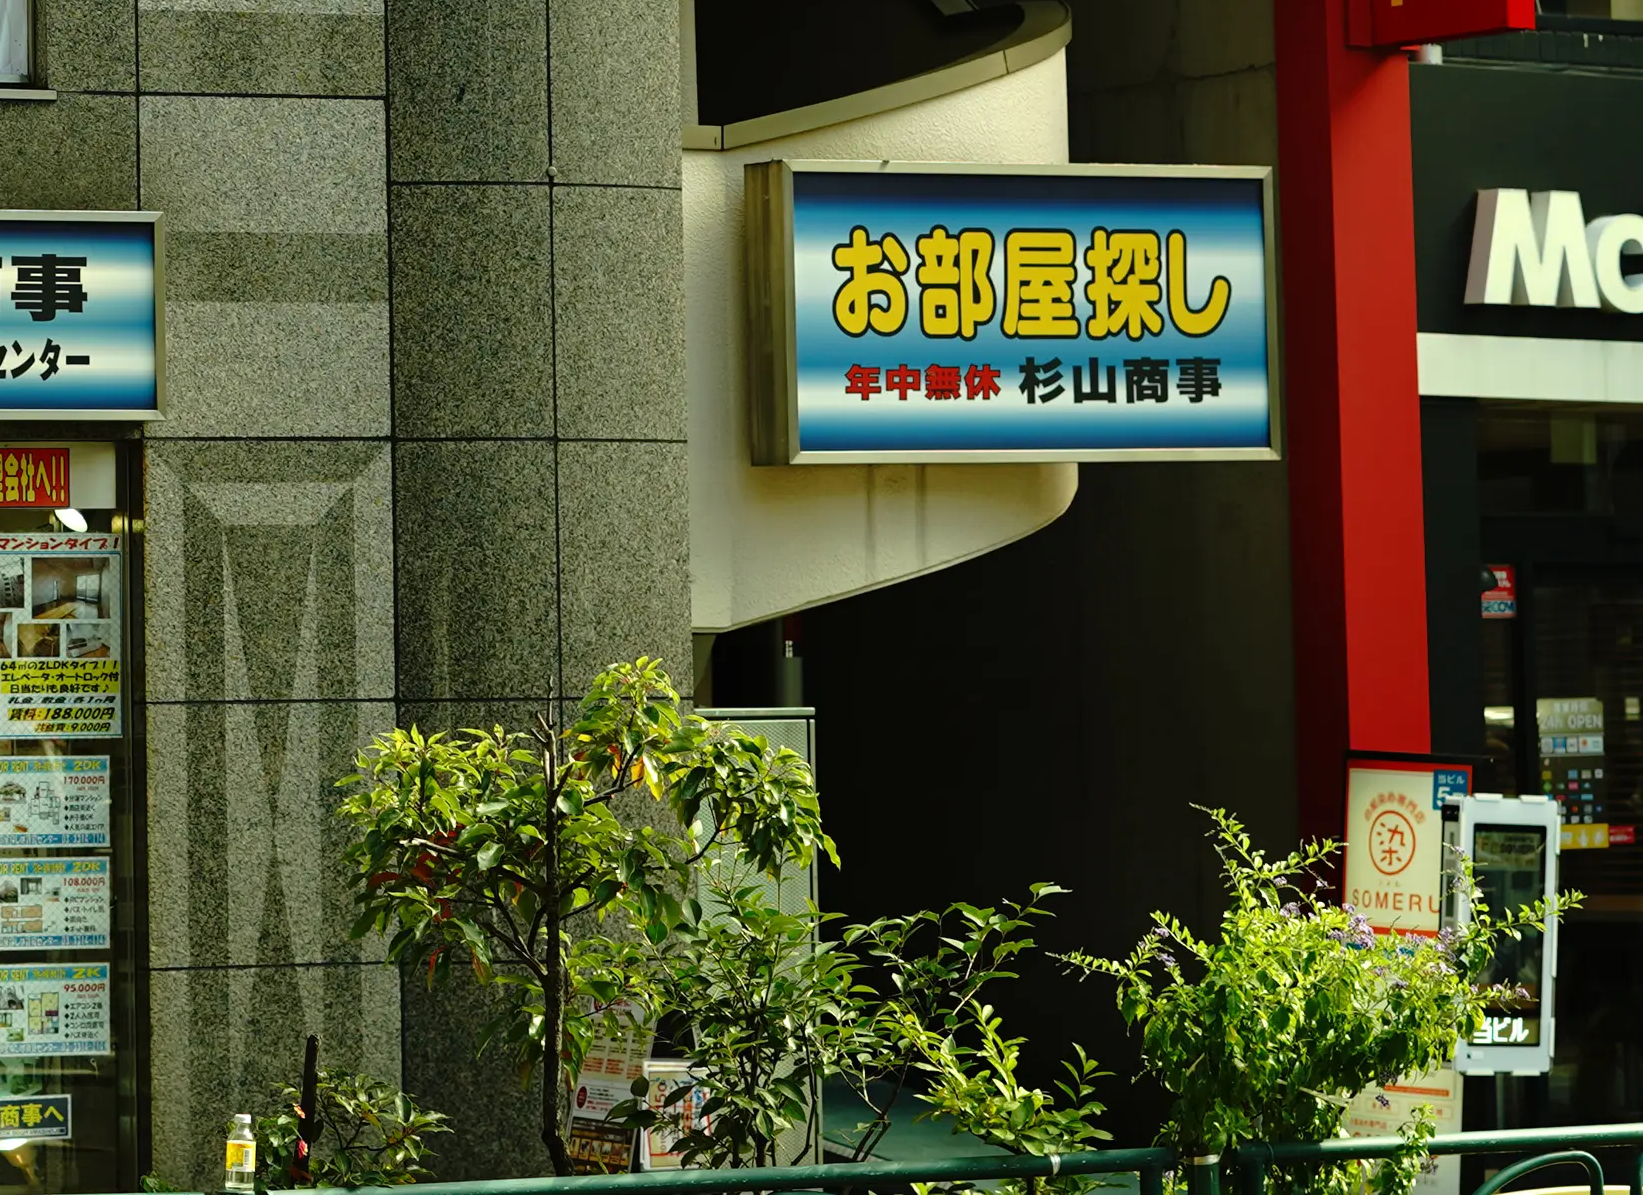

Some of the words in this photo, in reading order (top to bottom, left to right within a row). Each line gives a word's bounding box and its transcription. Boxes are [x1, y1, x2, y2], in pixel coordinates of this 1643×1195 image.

[832, 224, 1231, 341] お部屋探し
[844, 364, 1001, 401] 年中無休
[1019, 357, 1222, 404] 杉山商事
[1437, 773, 1465, 785] 当ビル
[1352, 889, 1441, 914] SOMERU
